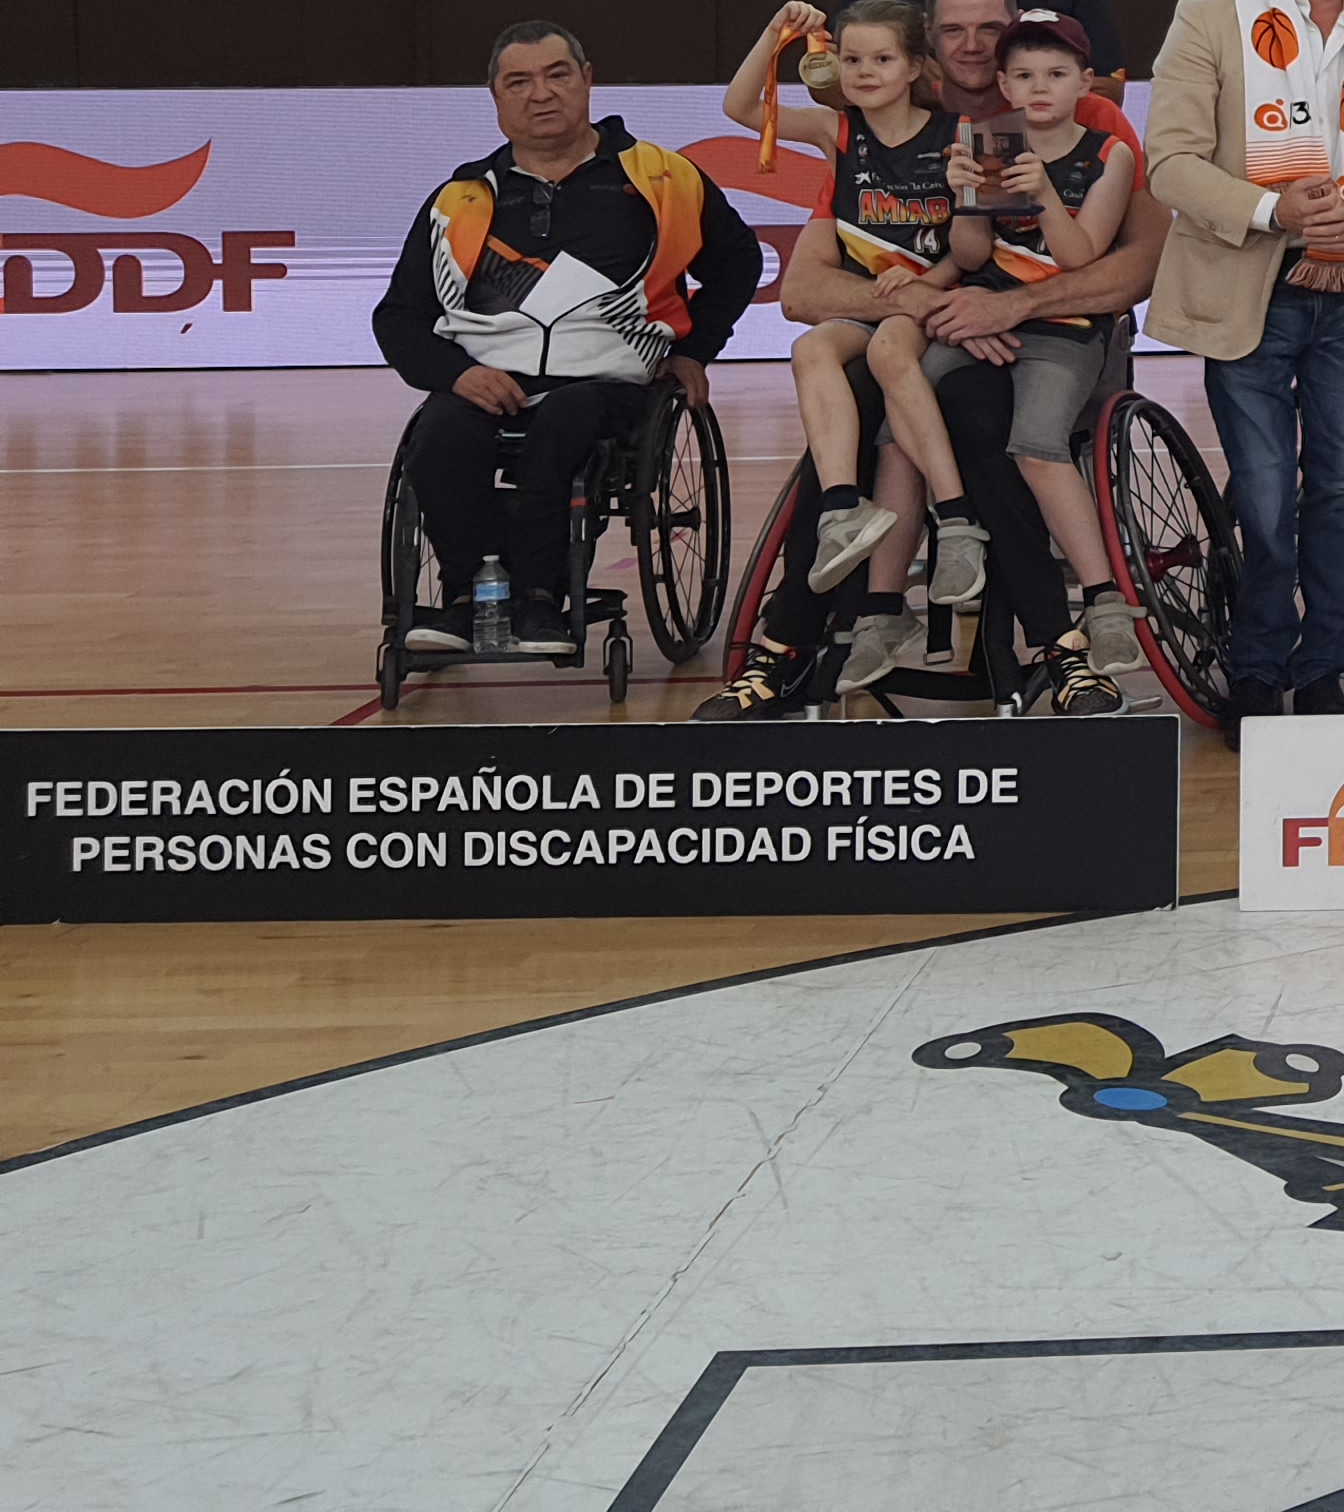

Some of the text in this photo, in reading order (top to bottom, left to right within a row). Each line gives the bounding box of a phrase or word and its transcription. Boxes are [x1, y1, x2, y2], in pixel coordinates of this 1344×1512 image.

[858, 188, 951, 226] AMIAB
[915, 228, 940, 254] 14
[0, 230, 295, 314] DDF
[26, 764, 1019, 818] FEDERACIÓN ESPAÑOLA DE DEPORTES DE
[72, 813, 977, 872] PERSONAS CON DISCAPACIDAD FÍSICA
